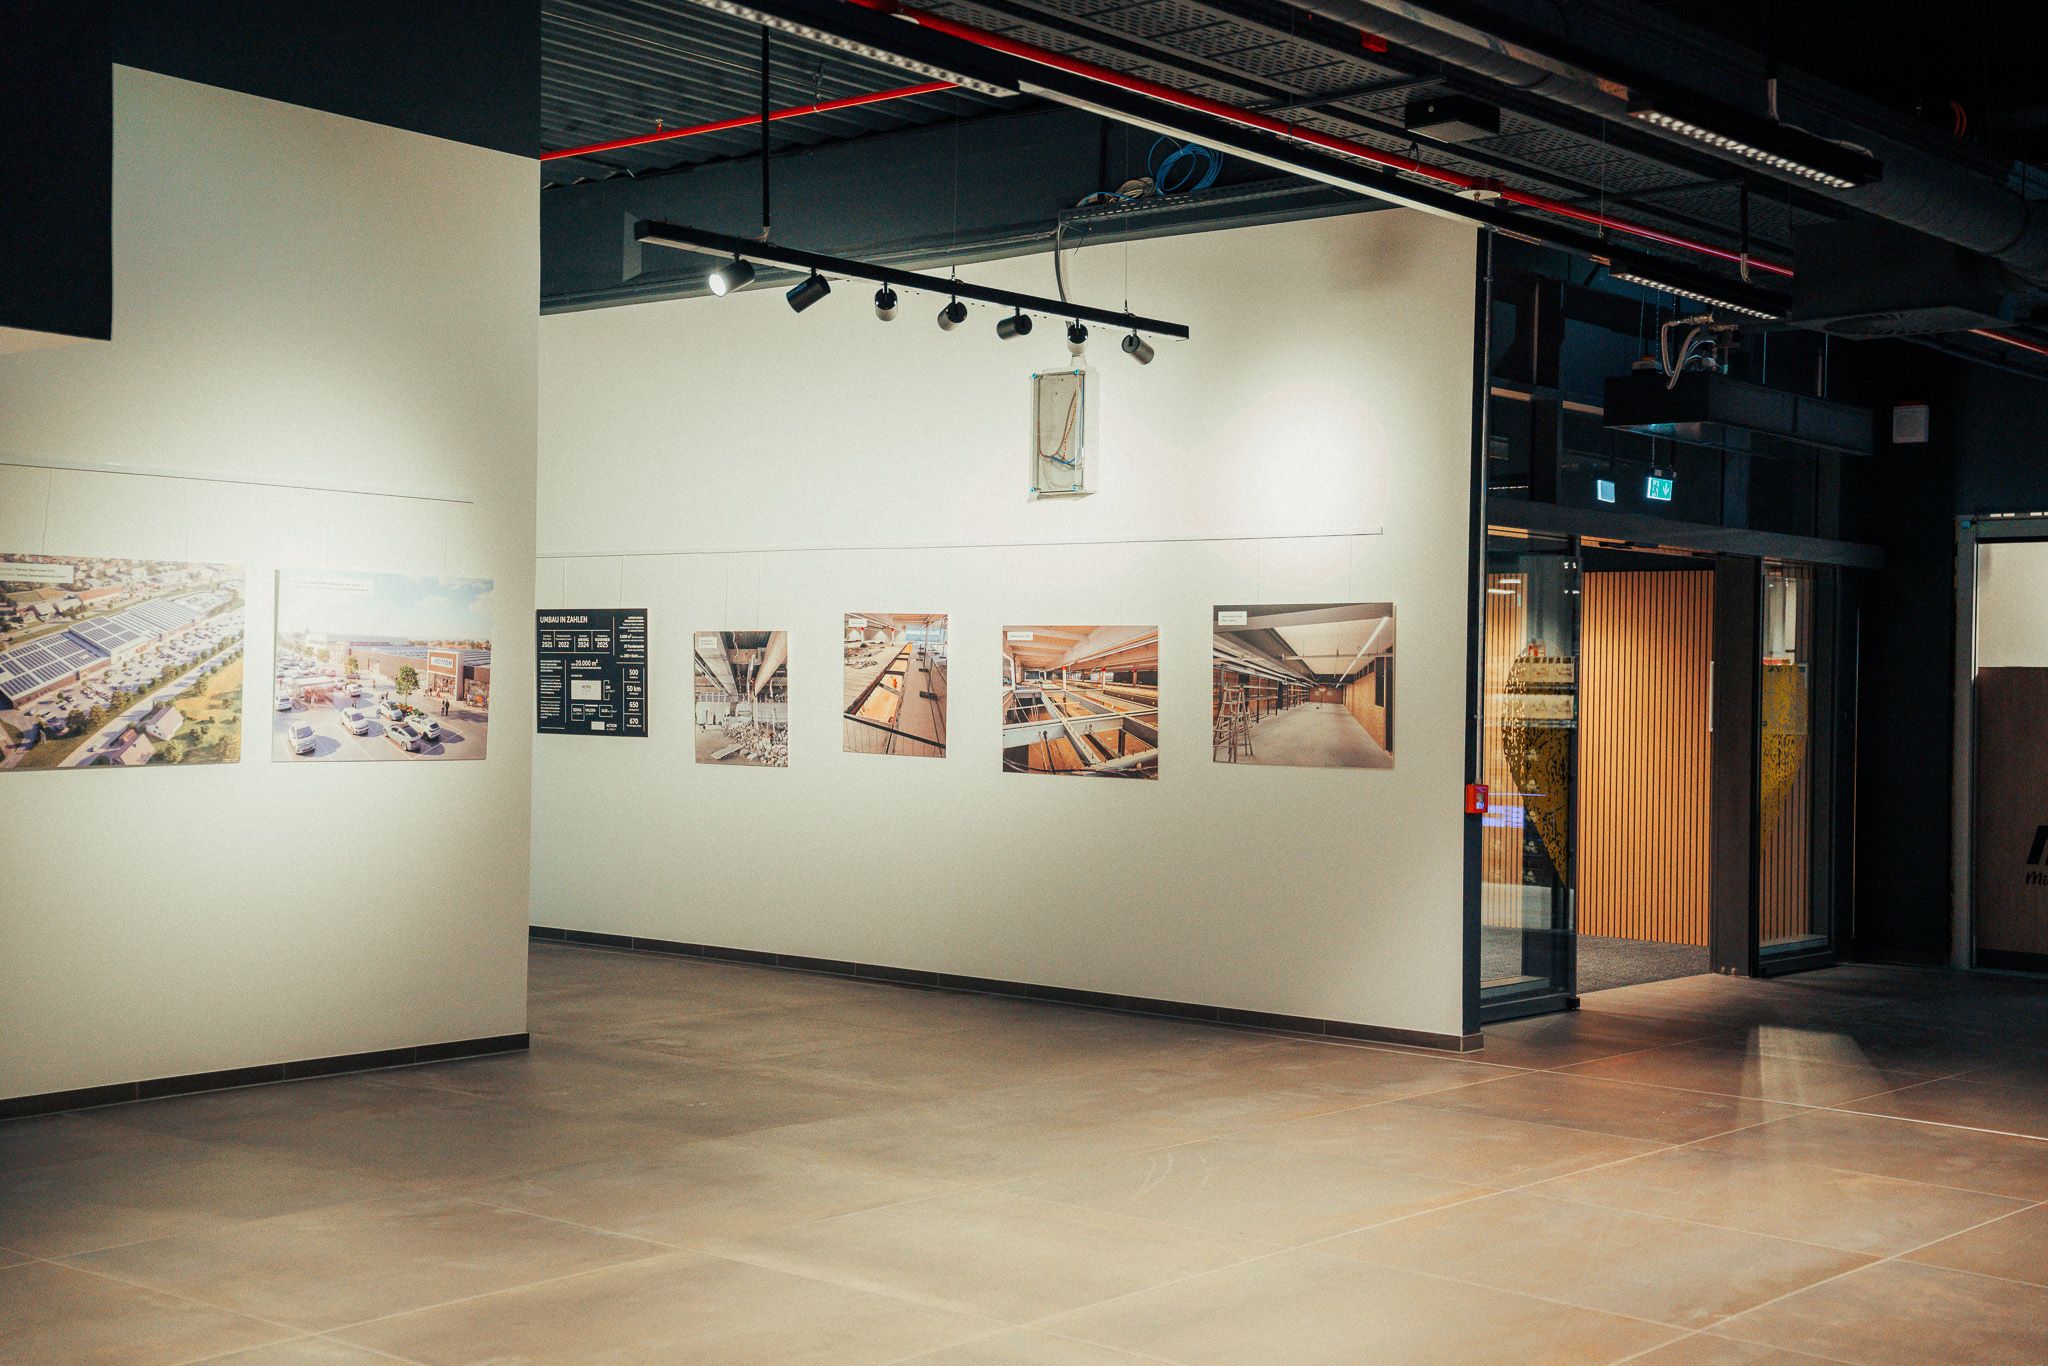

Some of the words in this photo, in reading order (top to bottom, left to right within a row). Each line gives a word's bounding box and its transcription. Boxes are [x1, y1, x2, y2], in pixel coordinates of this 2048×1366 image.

[575, 659, 591, 667] 20.000
[629, 717, 639, 725] 670
[2026, 871, 2048, 886] Mi
